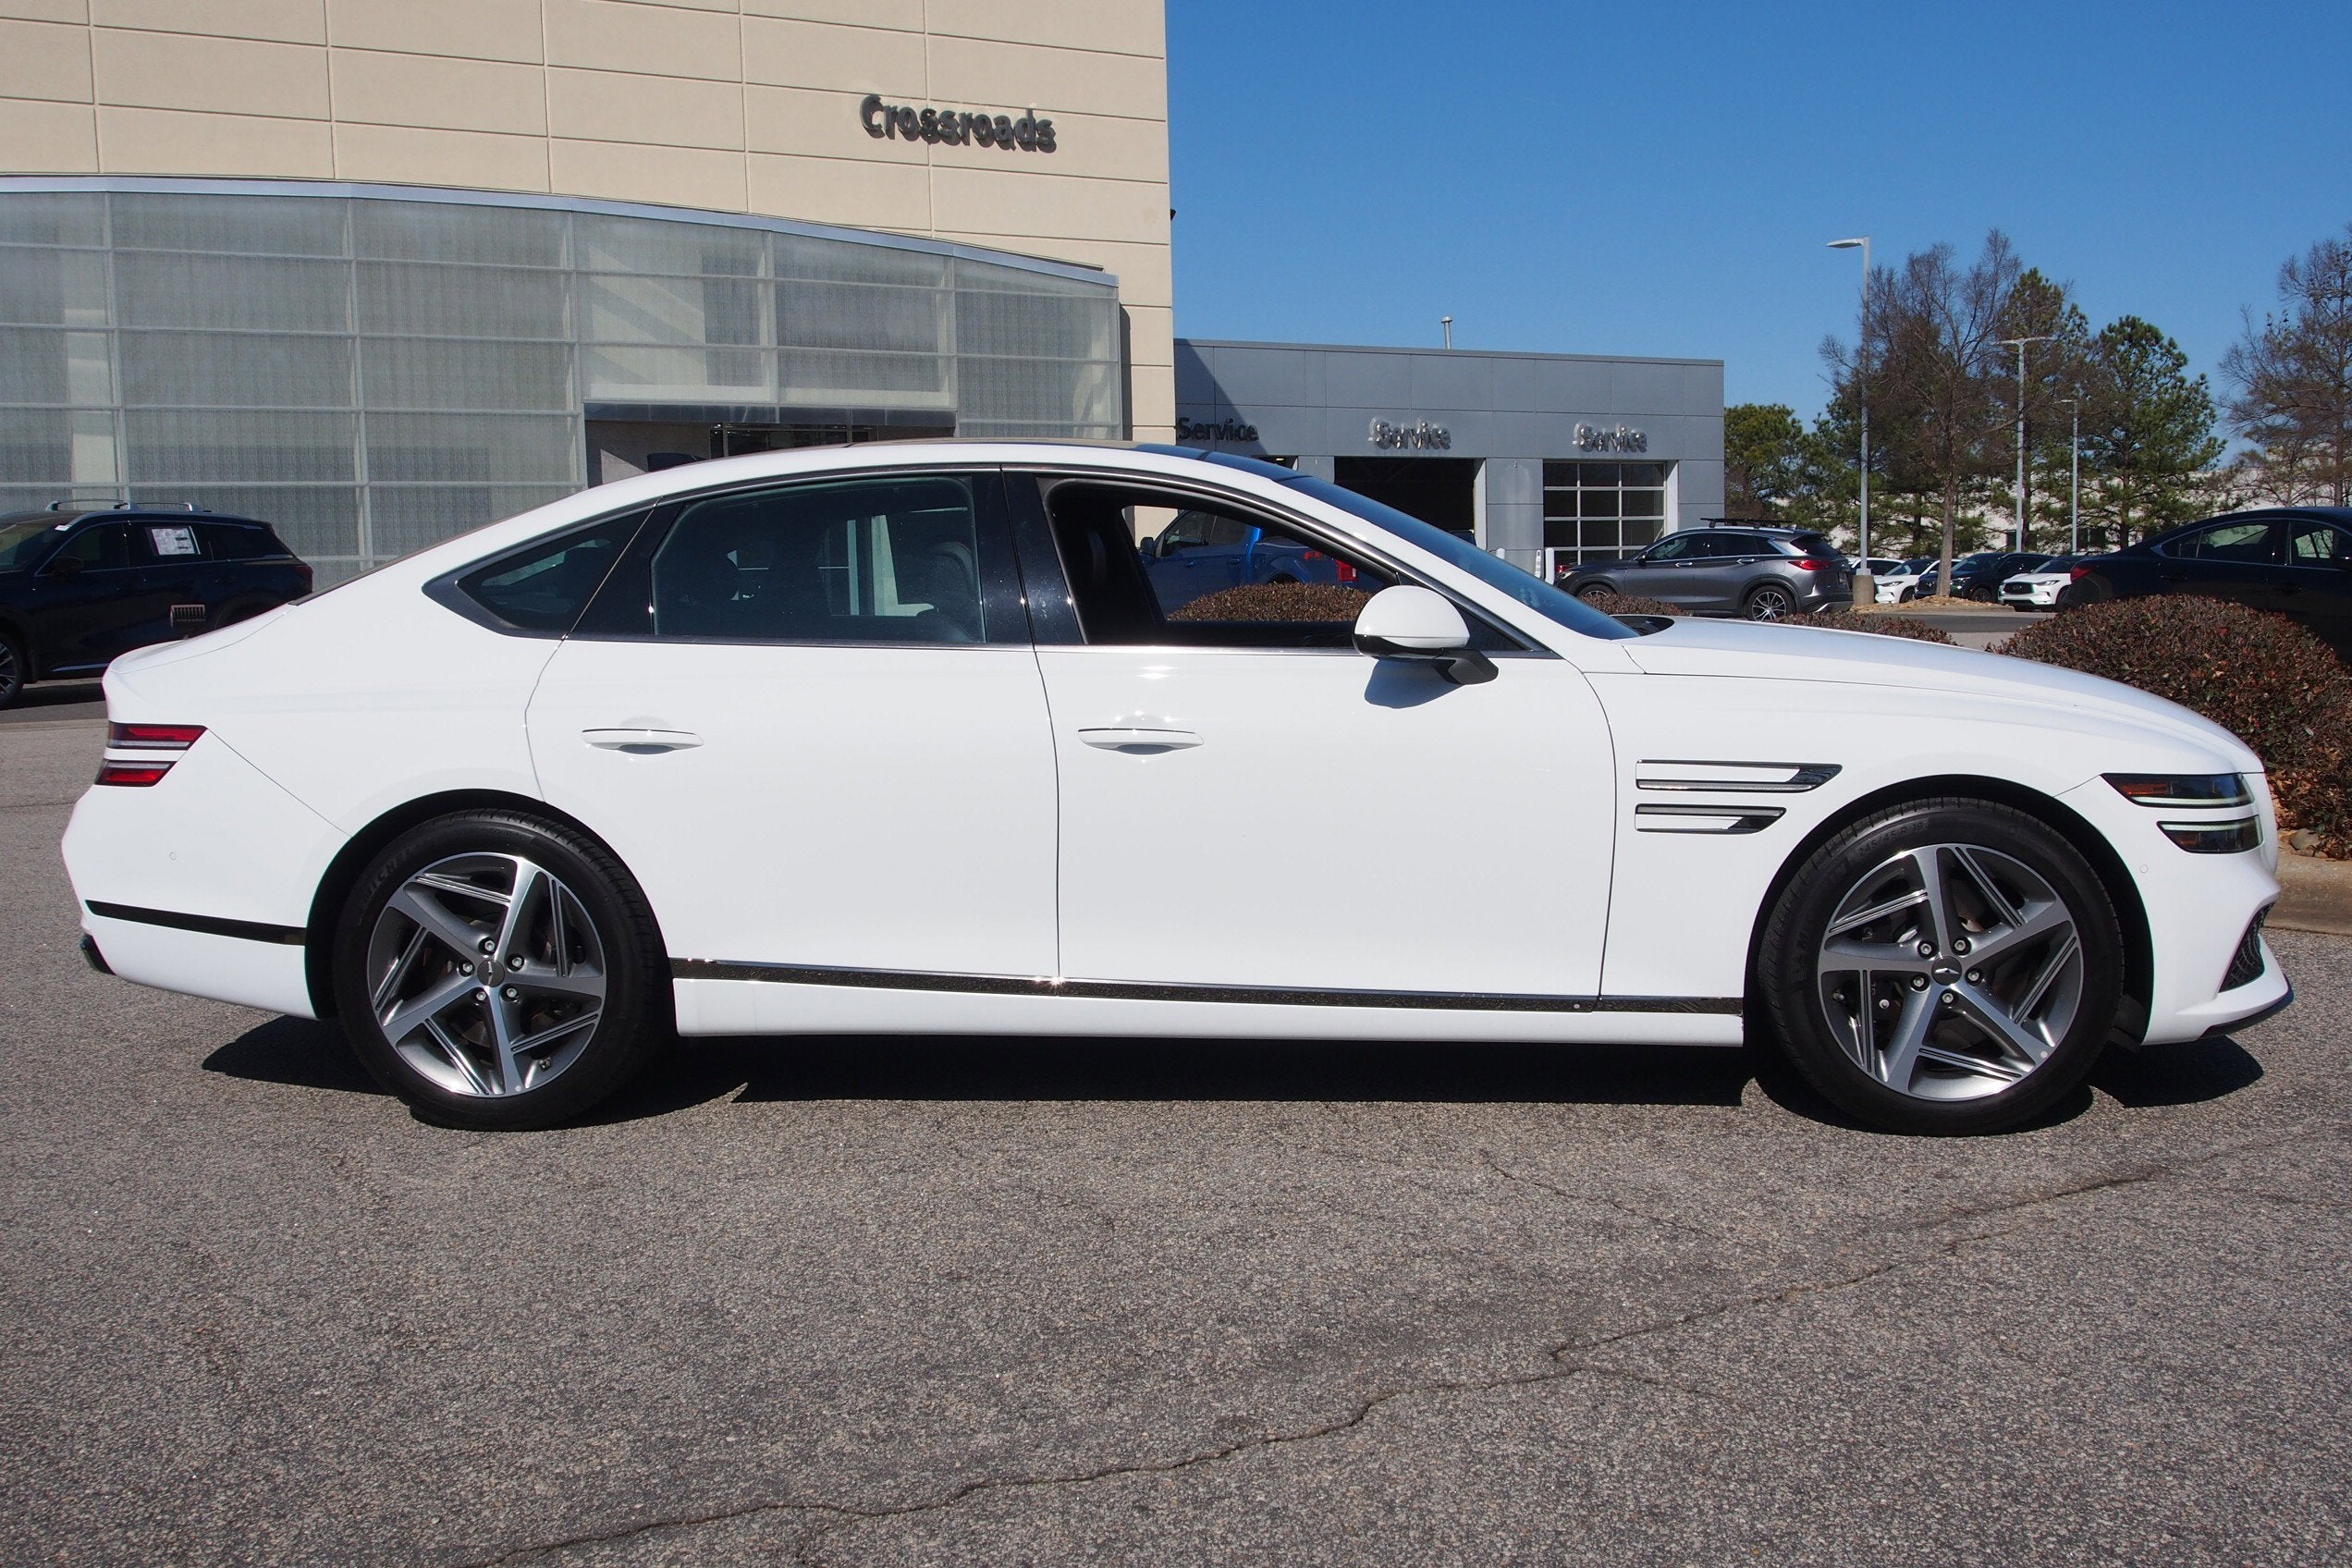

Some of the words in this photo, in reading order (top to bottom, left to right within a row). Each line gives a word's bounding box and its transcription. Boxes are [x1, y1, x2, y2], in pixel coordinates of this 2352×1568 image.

[860, 93, 1057, 151] Crossroads
[1177, 417, 1259, 441] Service
[1376, 421, 1451, 450] Service
[1579, 425, 1648, 453] Service
